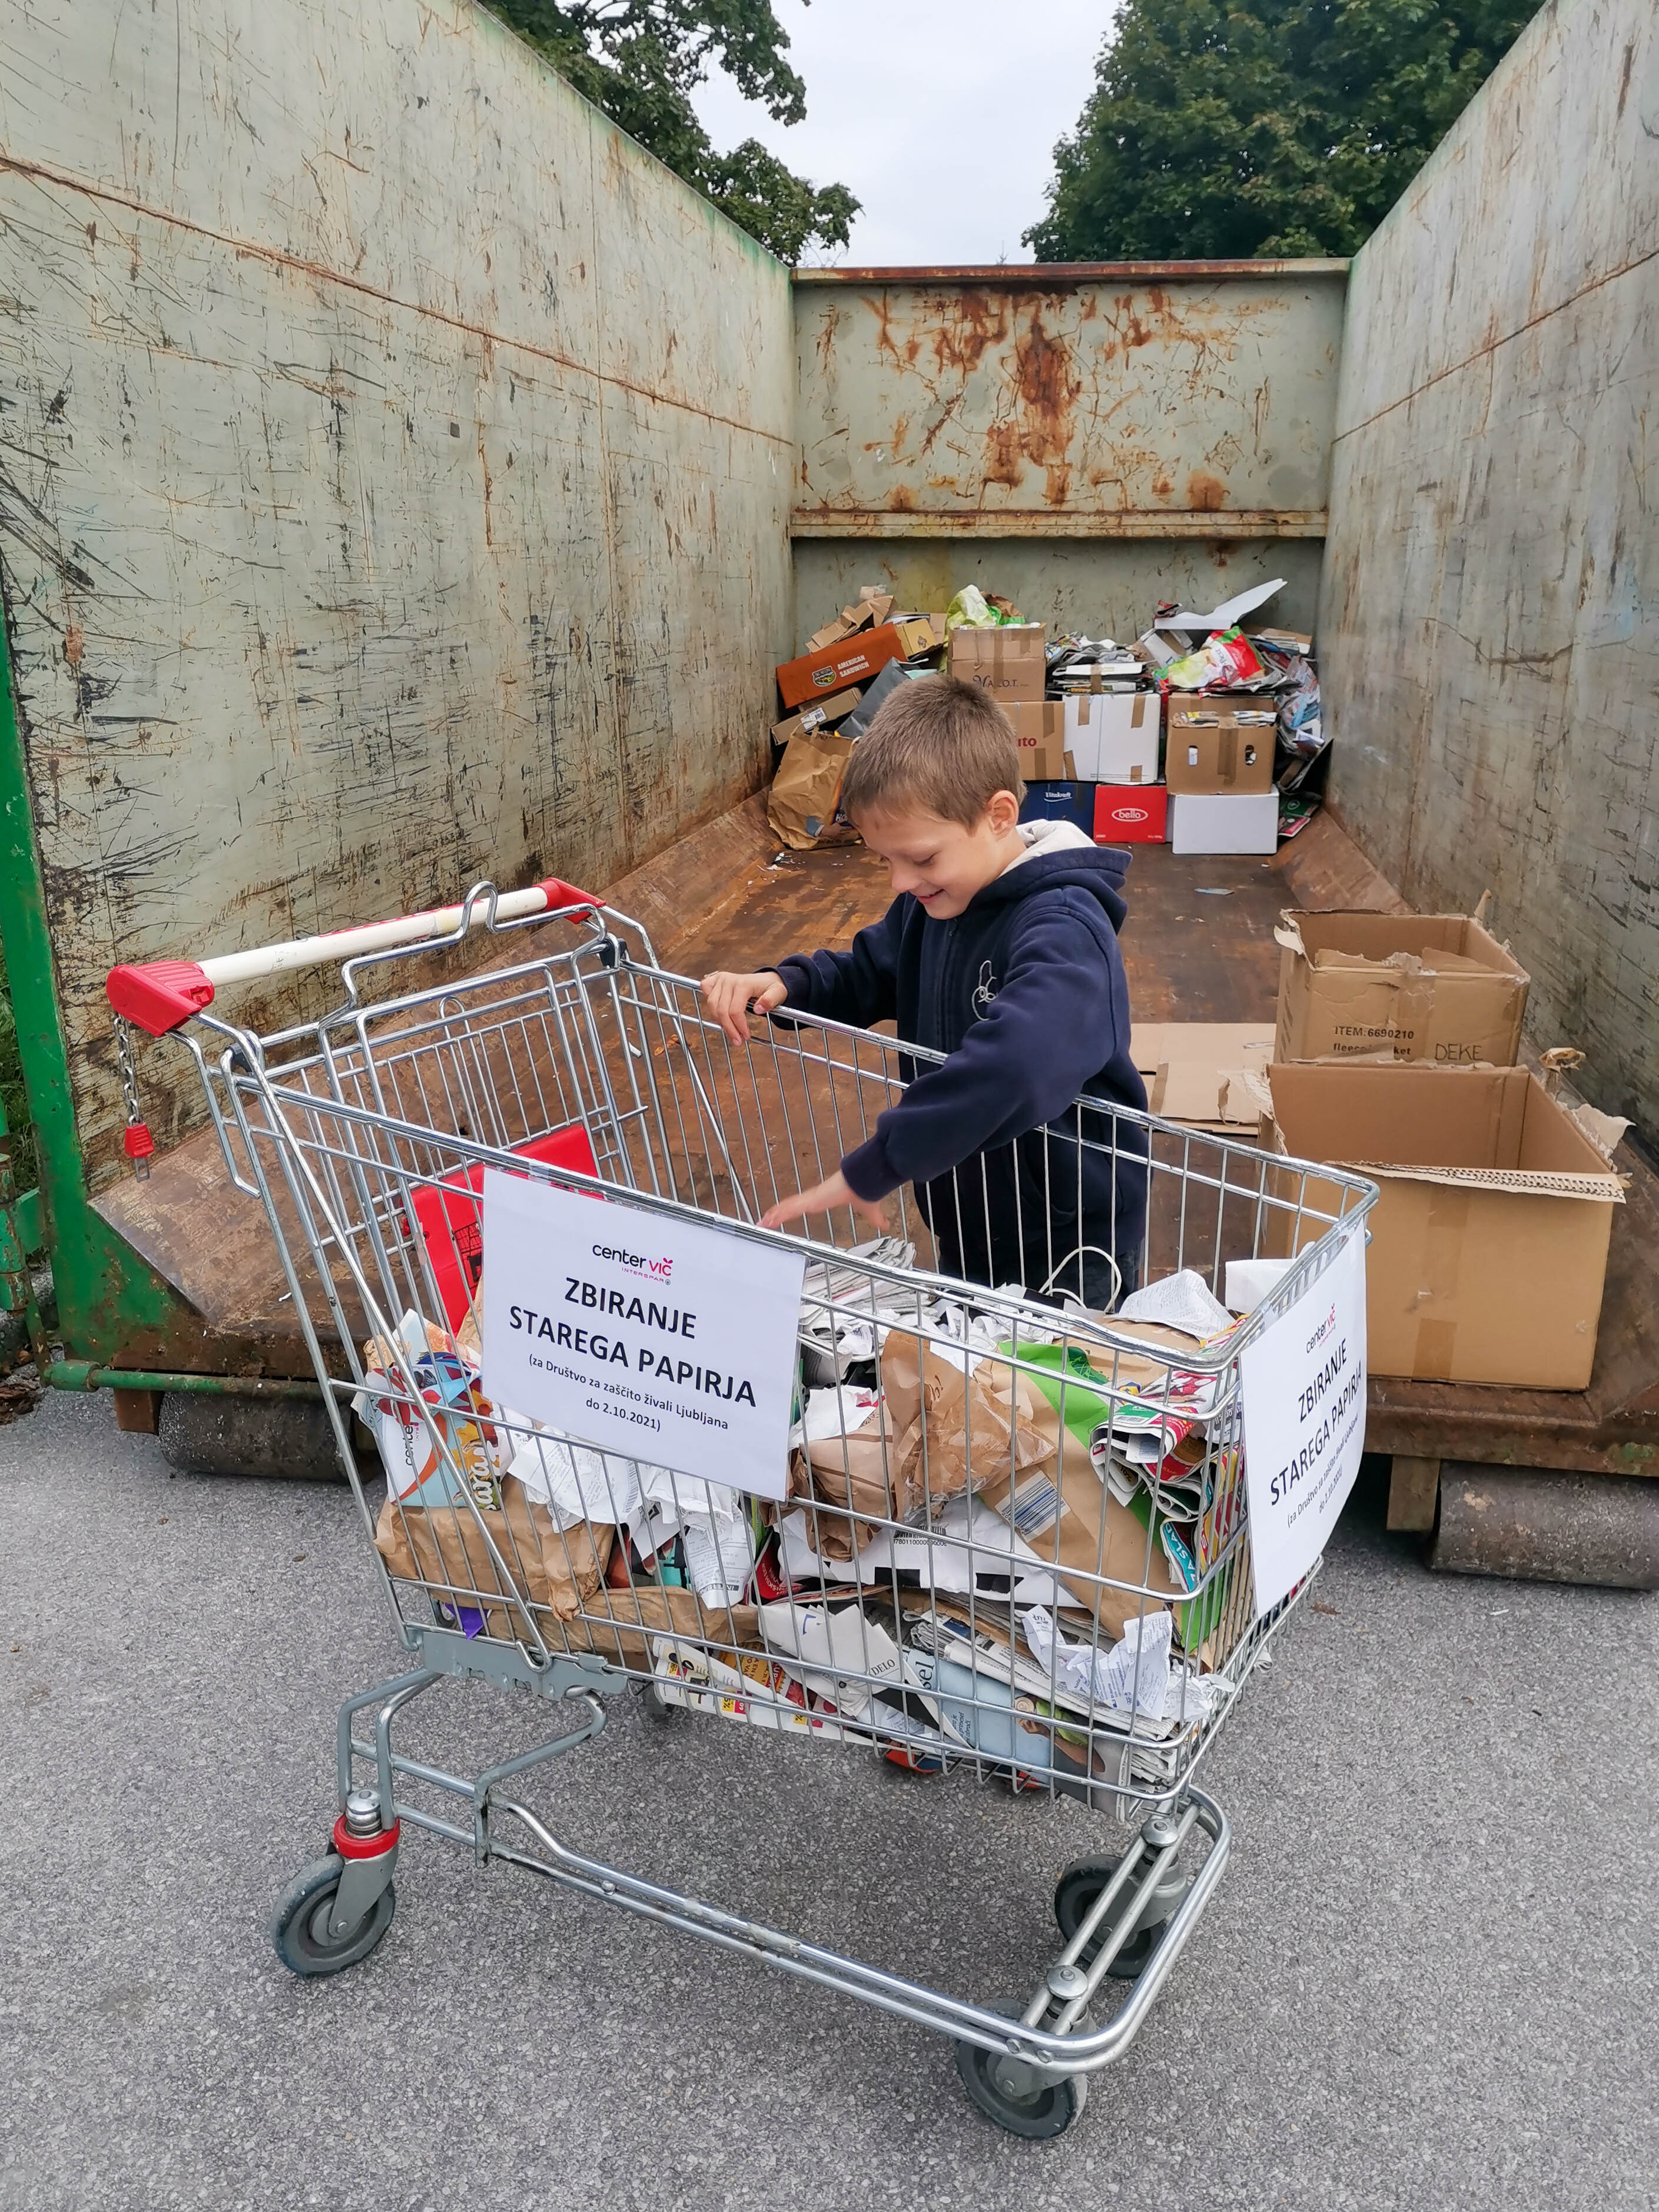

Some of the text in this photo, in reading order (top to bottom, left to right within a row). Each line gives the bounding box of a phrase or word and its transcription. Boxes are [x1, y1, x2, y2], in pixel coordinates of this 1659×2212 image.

[1118, 807, 1141, 819] bella
[1434, 1043, 1484, 1061] DEKE
[592, 1244, 673, 1276] center vič
[622, 1266, 664, 1284] INTERSPAR
[564, 1276, 697, 1339] ZBIRANJE
[1306, 1319, 1327, 1354] center
[509, 1305, 756, 1408] STAREGA PAPIRJA
[529, 1354, 729, 1430] (za Društvo za zaščito živali Ljubljana
[1298, 1338, 1347, 1423] ZBIRANJE
[585, 1397, 661, 1432] do 2.10.2021)
[1270, 1359, 1361, 1506] STAREGA PAPIRJA
[871, 1659, 895, 1676] DELO
